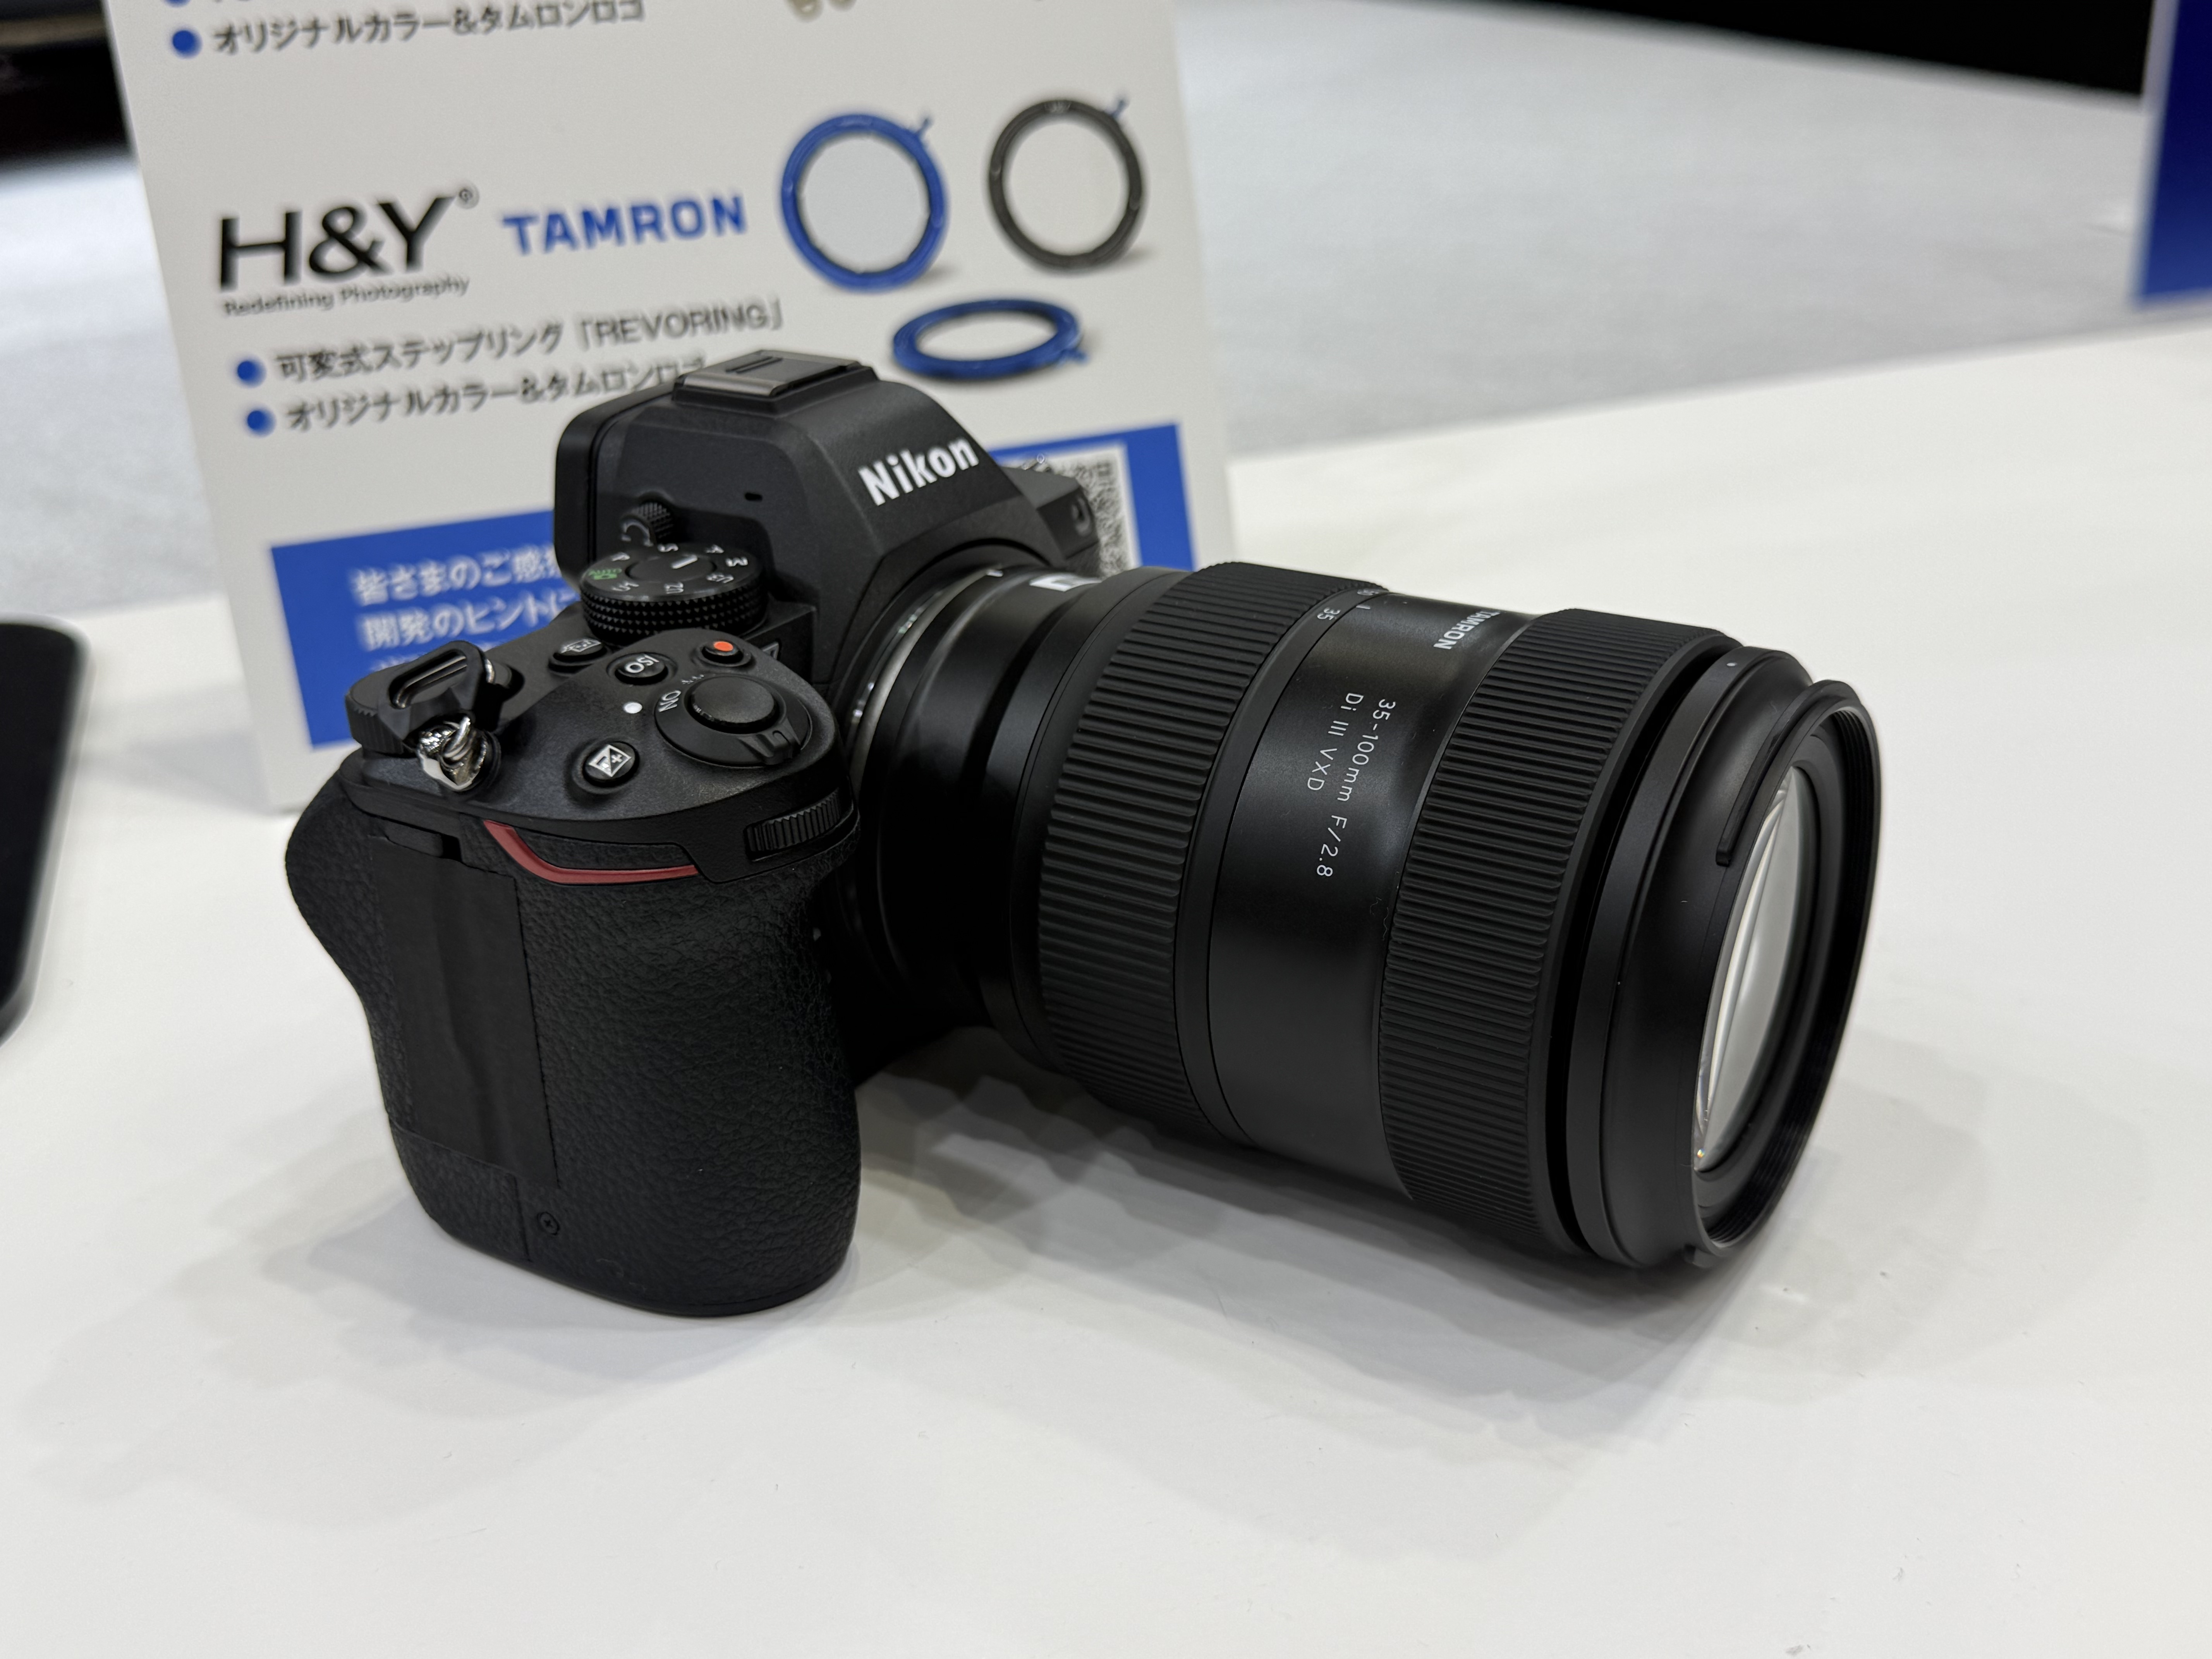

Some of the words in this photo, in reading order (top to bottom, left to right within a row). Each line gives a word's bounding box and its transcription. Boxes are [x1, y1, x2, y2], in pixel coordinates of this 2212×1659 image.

[501, 194, 747, 256] TAMRON
[224, 293, 335, 317] Redefining
[340, 275, 469, 304] Photography
[858, 437, 979, 506] Nikon
[1317, 607, 1341, 620] 35
[1433, 611, 1501, 650] TAMRON
[625, 654, 659, 673] ISO
[658, 690, 682, 713] ON
[1340, 692, 1364, 711] Di
[1328, 720, 1349, 736] III
[1307, 748, 1338, 791] VXD
[1337, 699, 1396, 802] 35-100mm
[1316, 815, 1348, 877] F/2.8
